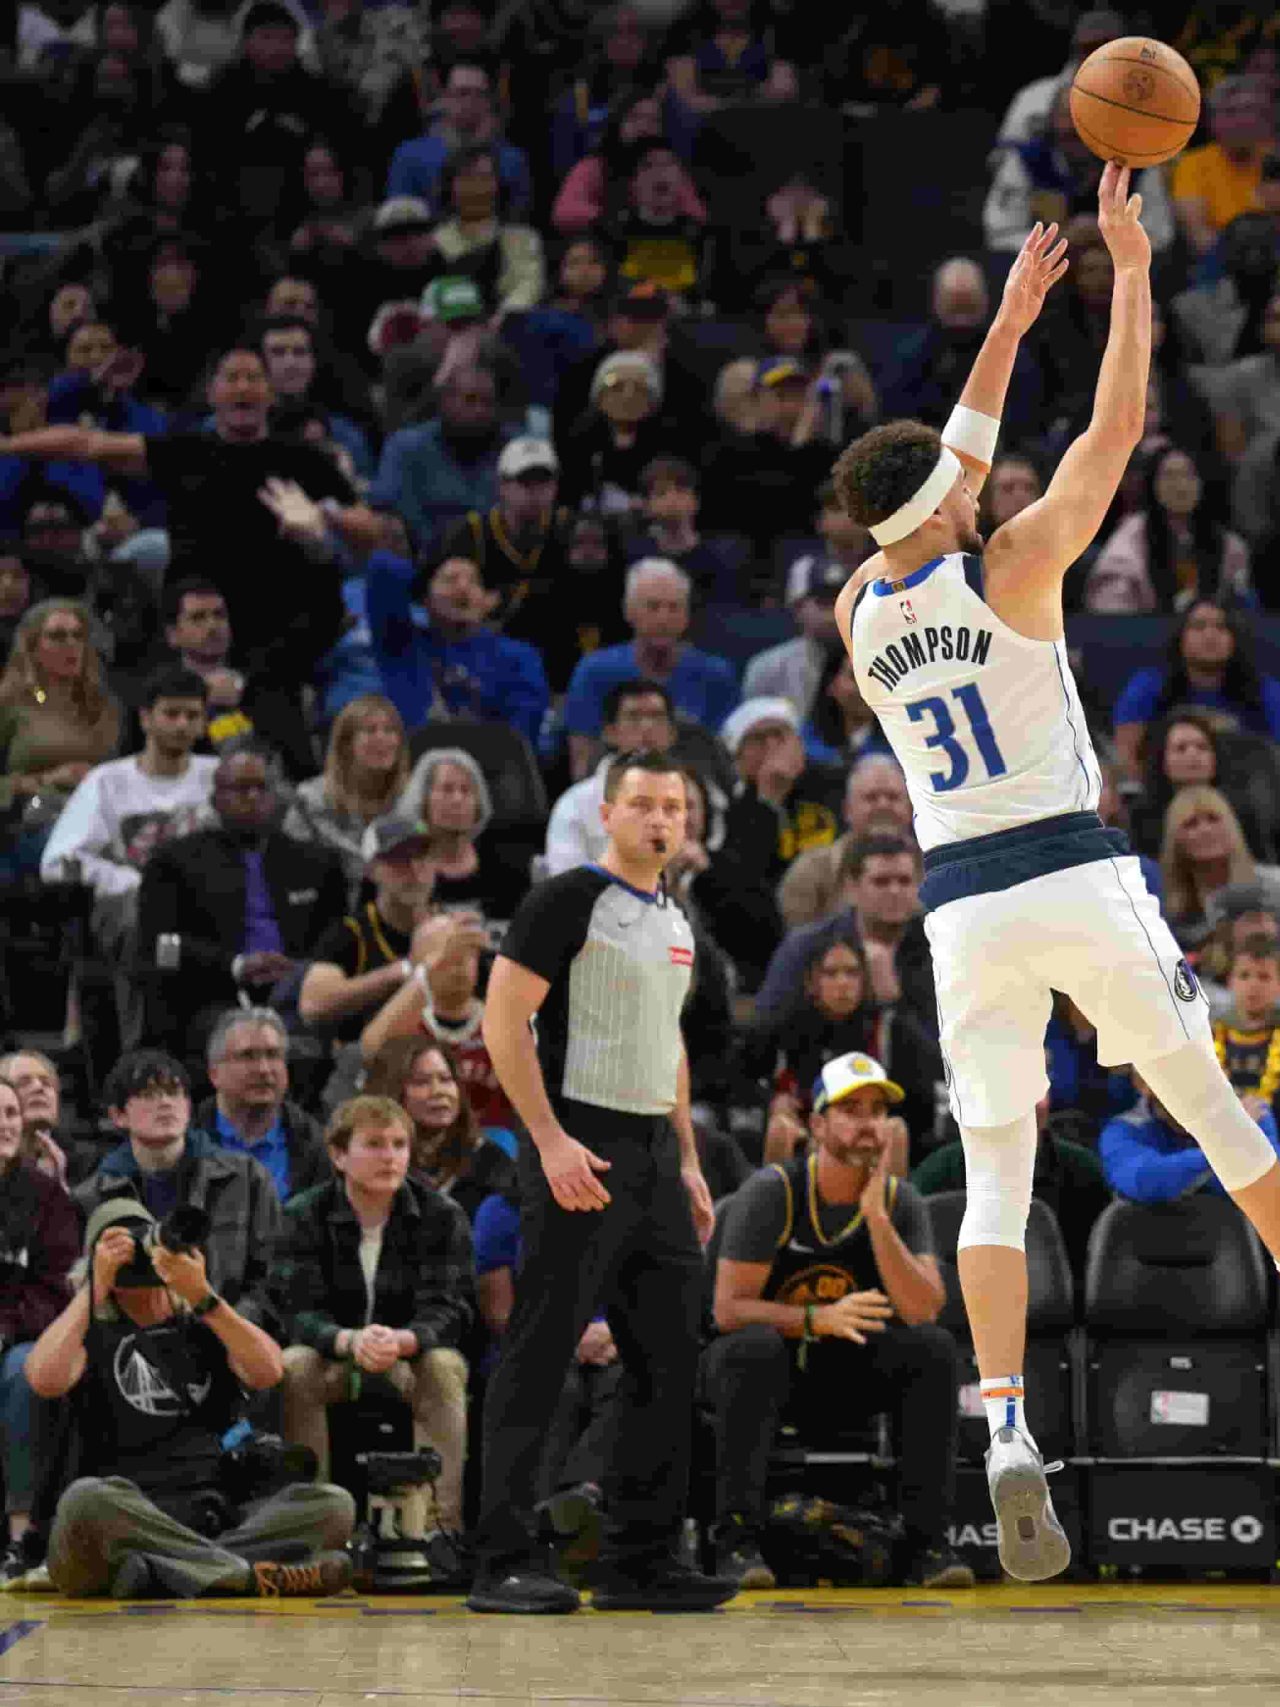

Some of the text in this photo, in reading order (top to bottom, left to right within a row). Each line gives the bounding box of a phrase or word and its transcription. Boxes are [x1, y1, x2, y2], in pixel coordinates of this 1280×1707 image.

[868, 626, 992, 692] THOMPSON
[905, 682, 1007, 793] 31
[1108, 1517, 1226, 1542] CHASE
